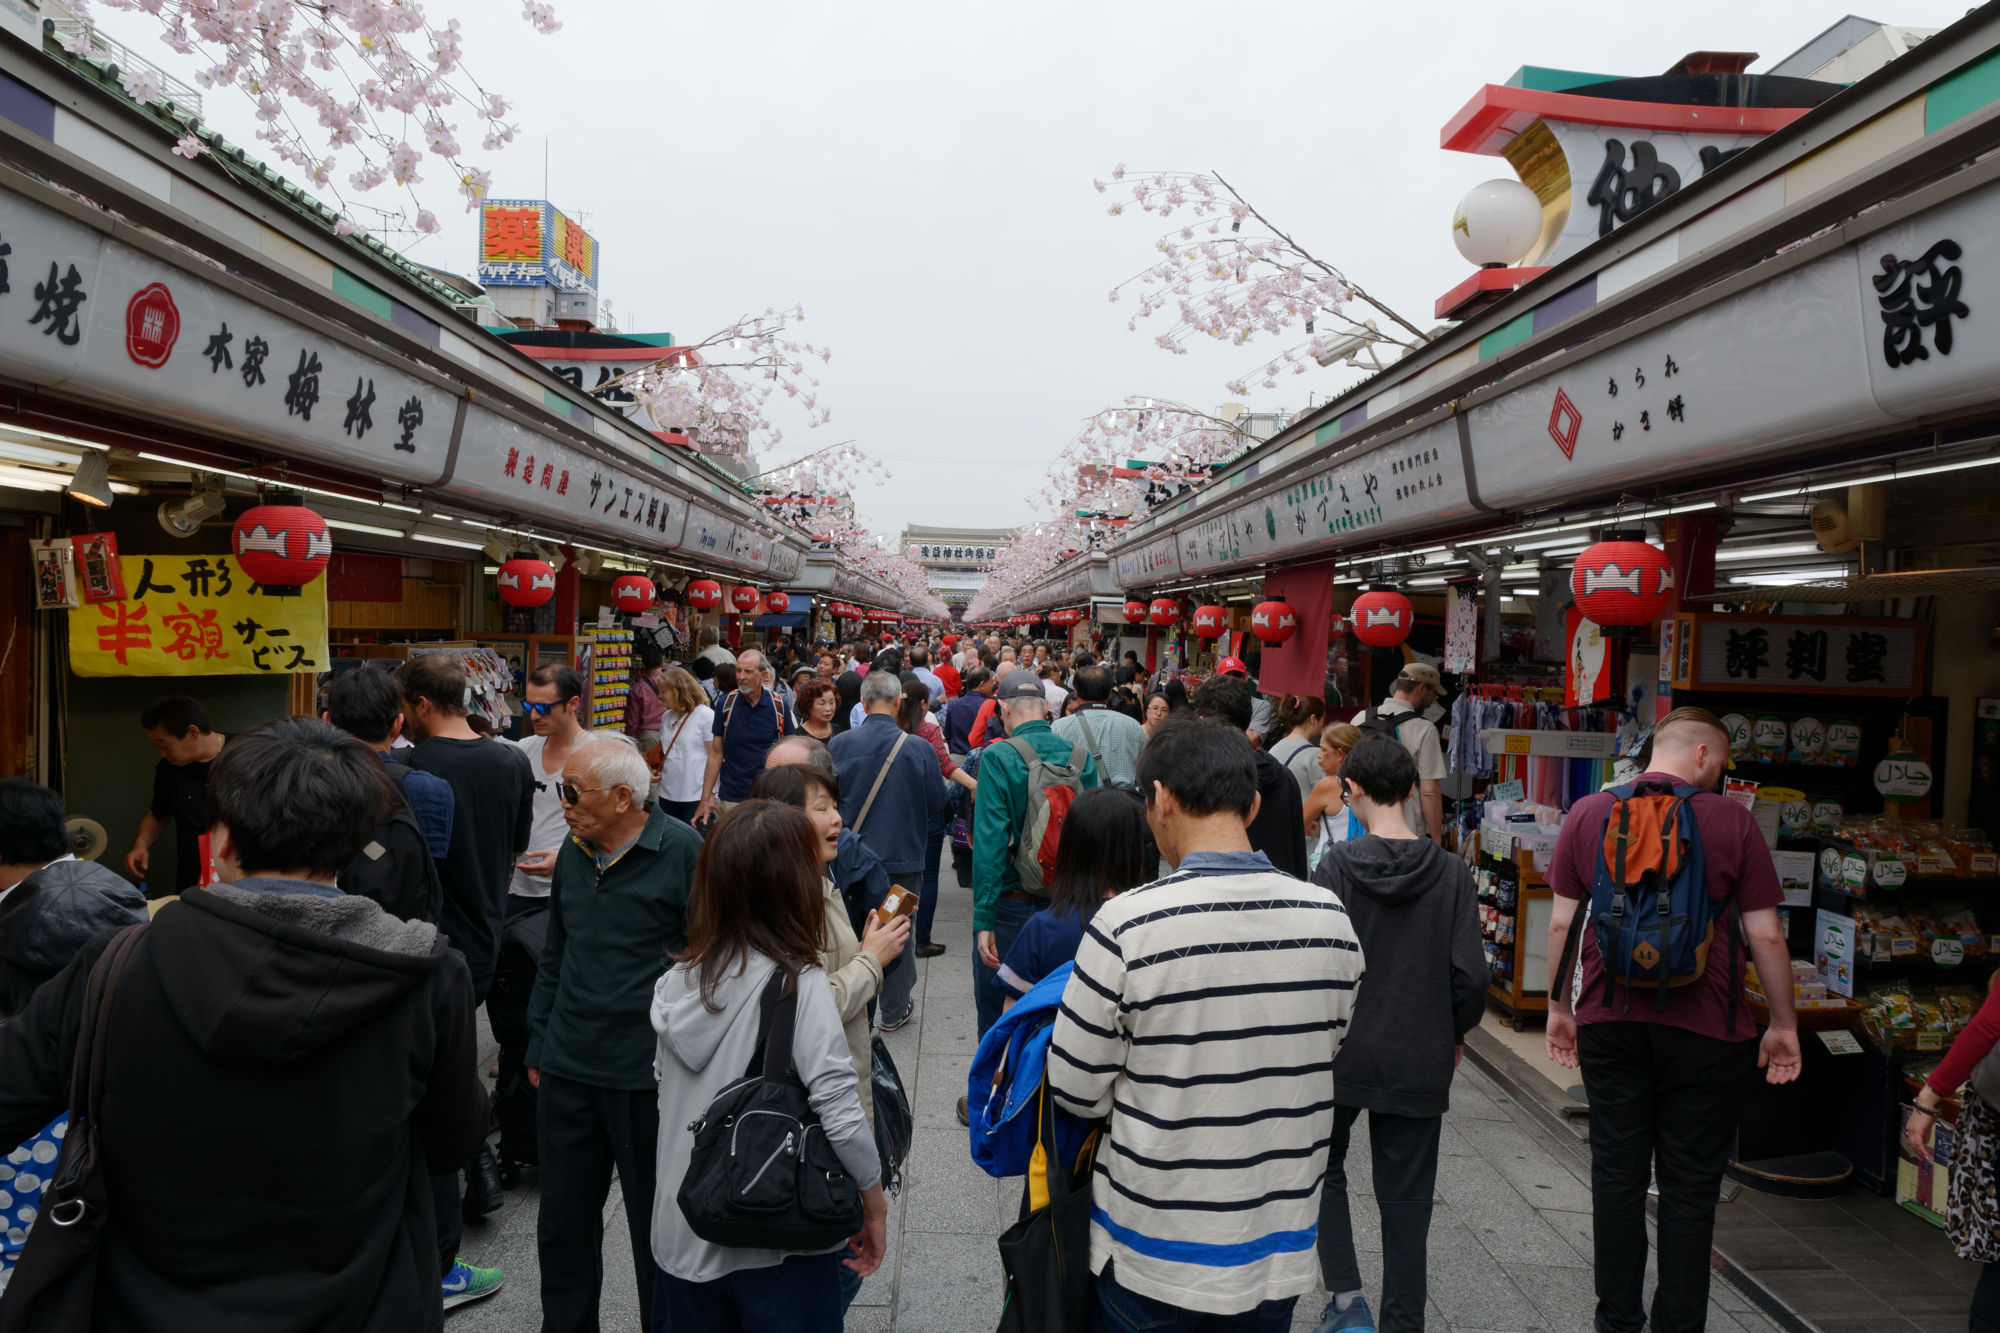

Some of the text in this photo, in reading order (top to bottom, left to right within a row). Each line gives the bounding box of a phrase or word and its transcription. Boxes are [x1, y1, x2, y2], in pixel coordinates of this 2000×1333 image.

[484, 207, 540, 258] 薬
[565, 218, 585, 271] 薬
[478, 262, 547, 280] マツモトキヨシ
[1872, 238, 1970, 369] 評
[203, 322, 424, 453] 本家梅林堂
[1608, 353, 1680, 398] あられ
[1613, 394, 1685, 441] かき餅
[503, 446, 570, 496] 製造問屋
[133, 557, 264, 600] 人形
[96, 600, 230, 666] 半額
[233, 617, 290, 645] サー
[252, 644, 316, 671] ビス
[1724, 627, 1888, 683] 評判堂
[1755, 721, 1785, 738] حلال
[1828, 726, 1858, 742] حلال
[1877, 764, 1930, 783] حلال
[1875, 864, 1905, 878] حلال
[1823, 931, 1846, 947] حلال
[1933, 942, 1962, 956] حلال
